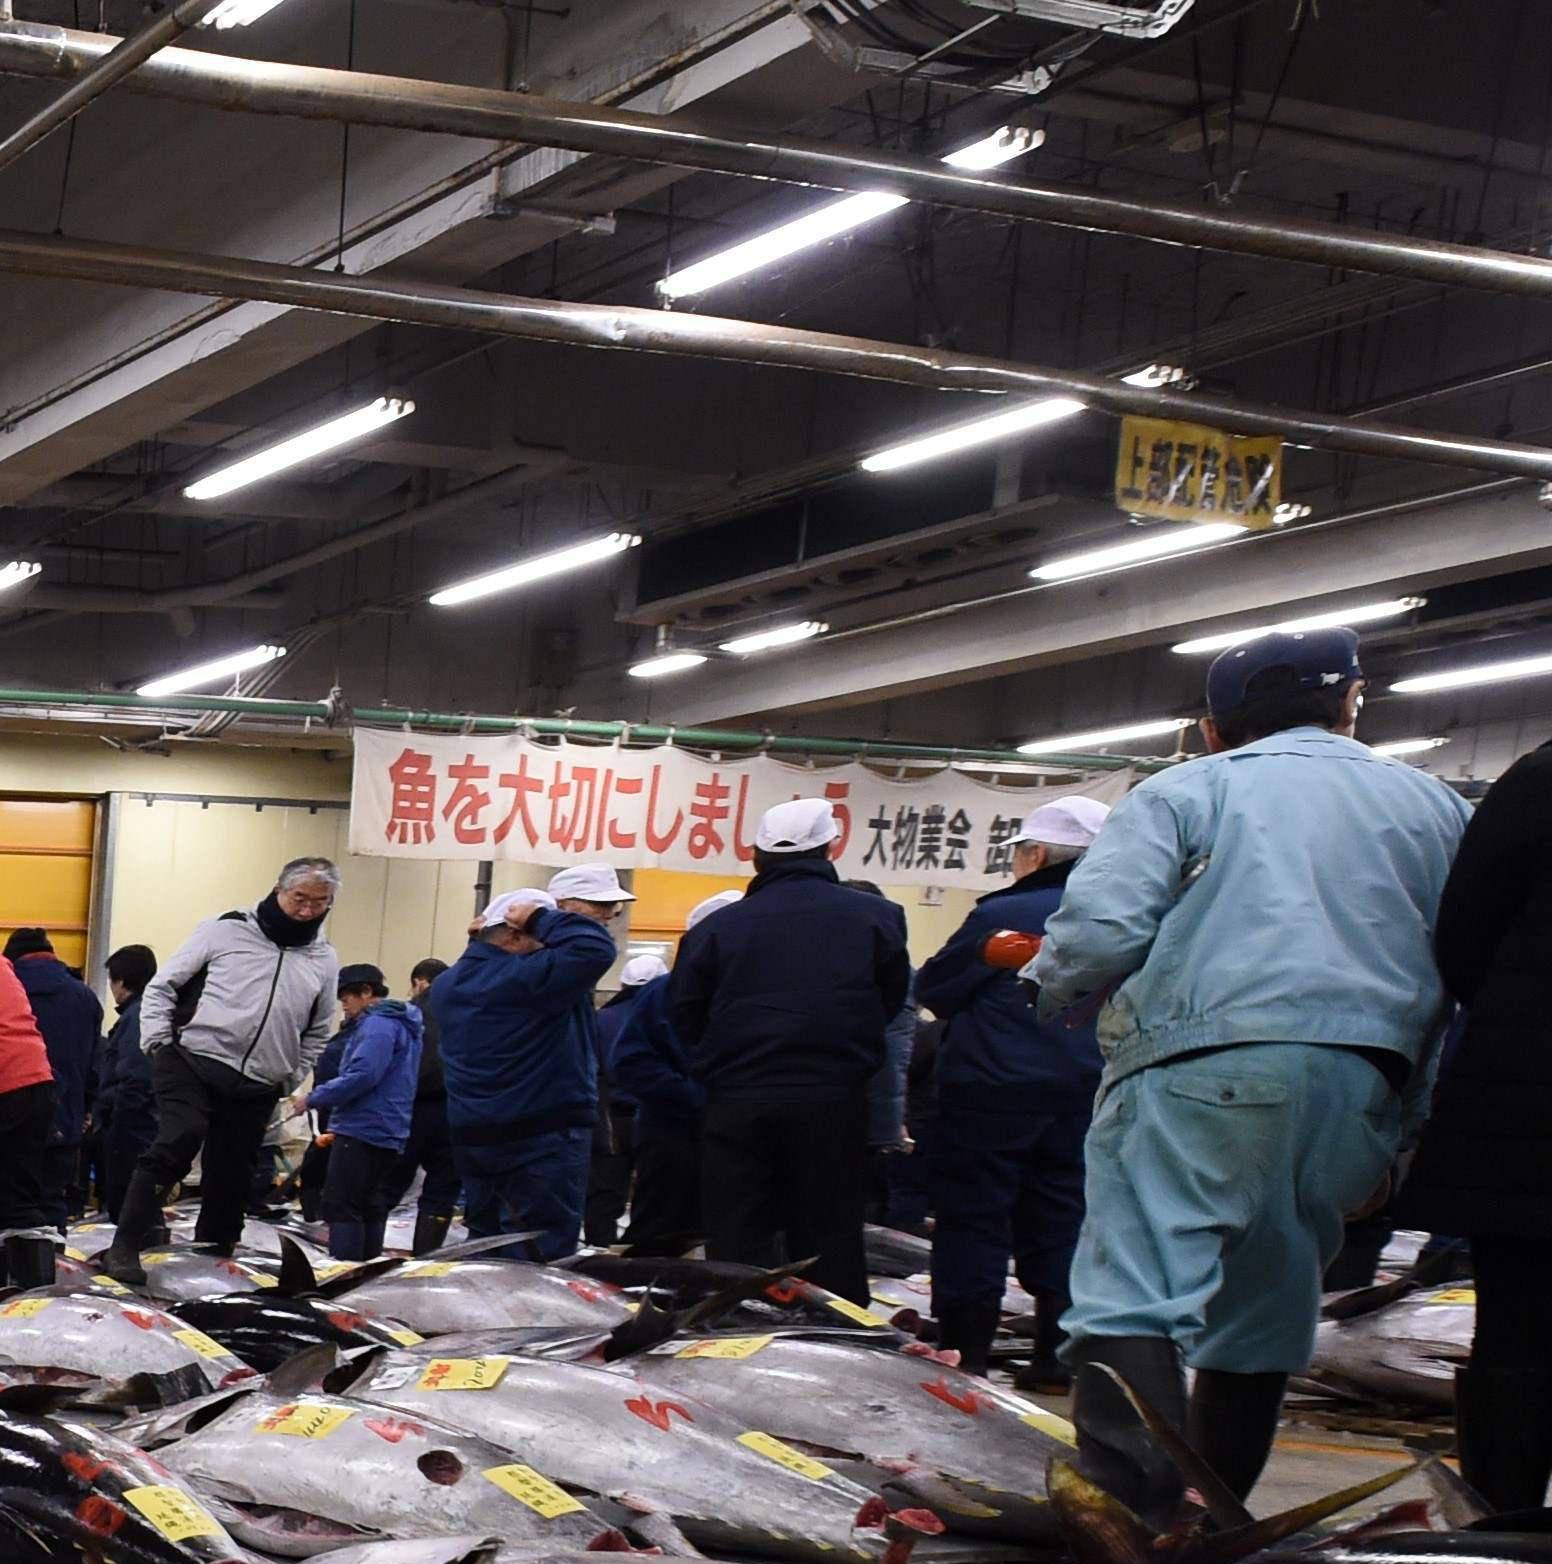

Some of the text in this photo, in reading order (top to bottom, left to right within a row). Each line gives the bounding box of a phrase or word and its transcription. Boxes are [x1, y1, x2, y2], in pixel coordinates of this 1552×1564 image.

[384, 747, 852, 862] 魚を大切にしましう
[862, 804, 973, 871] 大物業会
